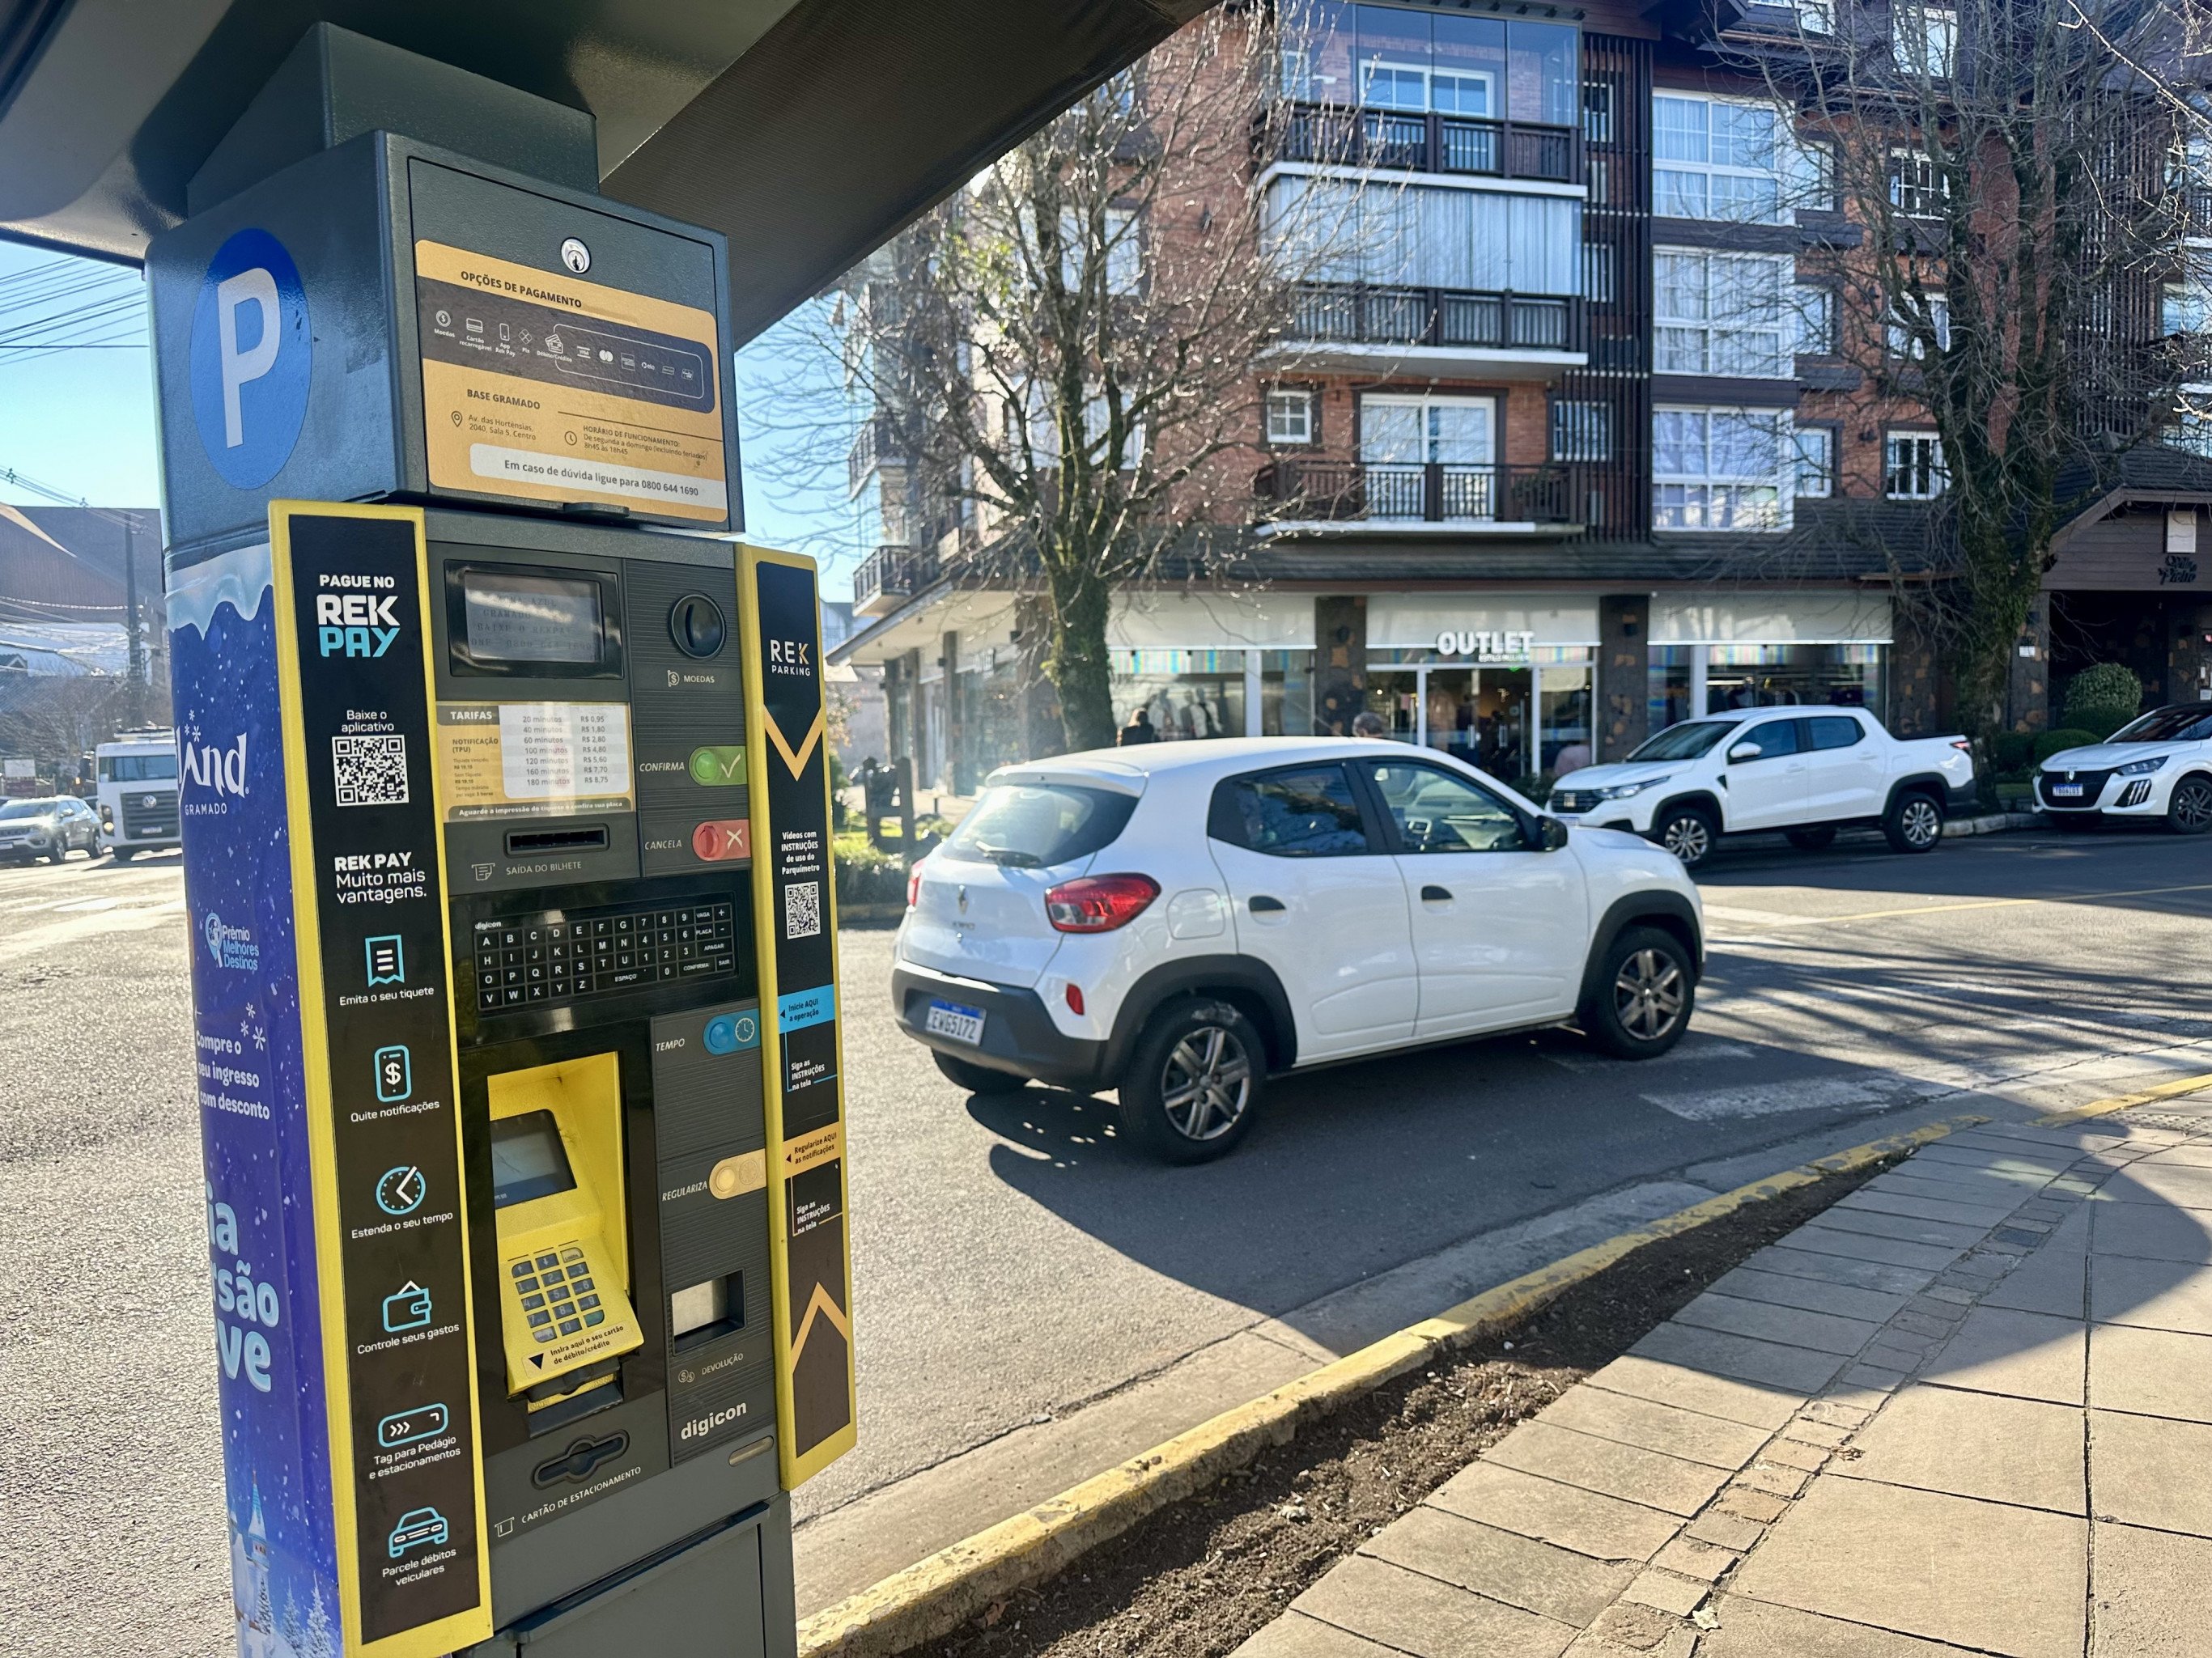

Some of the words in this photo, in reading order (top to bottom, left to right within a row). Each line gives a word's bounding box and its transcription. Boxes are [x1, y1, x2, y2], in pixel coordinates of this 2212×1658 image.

[461, 270, 502, 289] OPÇÕES
[504, 282, 517, 292] DE
[520, 285, 582, 307] PAGAMENTO
[434, 328, 456, 338] Moedas
[466, 335, 484, 344] Cartão
[459, 341, 492, 352] recarregável
[218, 267, 281, 448] P
[467, 389, 490, 401] BASE
[493, 394, 541, 409] GRAMADO
[468, 414, 478, 422] Av.
[481, 417, 494, 425] das
[495, 419, 534, 432] Hortênsias,
[469, 423, 487, 433] 2040,
[490, 427, 503, 435] Sala
[513, 430, 536, 440] Centro
[584, 426, 613, 436] HORÁRIO
[625, 432, 680, 447] FUNCIONAMENTO:
[594, 435, 620, 446] segunda
[626, 441, 652, 452] domingo
[610, 447, 628, 455] 18h45
[504, 460, 520, 471] Em
[523, 464, 544, 474] caso
[547, 466, 558, 476] de
[562, 469, 592, 481] dúvida
[595, 473, 617, 486] ligue
[620, 478, 639, 488] para
[642, 481, 661, 490] 0800
[664, 483, 677, 494] 644
[681, 486, 698, 496] 1690
[320, 575, 371, 587] PAGUE
[374, 576, 395, 588] NO
[316, 594, 401, 626] REK
[319, 626, 401, 658] PAY
[1437, 631, 1535, 655] OUTLET
[771, 639, 809, 664] REK
[683, 675, 715, 683] MOEDAS
[772, 665, 810, 676] PARKING
[346, 710, 377, 720] Baixe
[380, 711, 387, 719] o
[450, 711, 492, 720] TARIFAS
[591, 715, 605, 723] 0,95
[342, 722, 394, 735] aplicativo
[452, 737, 499, 745] NOTIFICAÇÃO
[592, 736, 606, 744] 2,80
[639, 762, 685, 772] CONFIRMA
[185, 803, 227, 816] GRAMADO
[459, 808, 488, 816] Aguarde
[495, 806, 529, 814] impressão
[782, 832, 803, 840] Vídeos
[644, 840, 682, 850] CANCELA
[782, 840, 818, 851] INSTRUÇÕES
[334, 854, 371, 871] REK
[375, 852, 411, 868] PAY
[786, 854, 794, 863] de
[507, 864, 533, 876] SAÍDA
[535, 864, 548, 872] DO
[550, 861, 581, 871] BILHETE
[782, 864, 820, 876] Parquímetro
[336, 872, 383, 888] Muito
[388, 868, 426, 884] mais
[337, 886, 427, 904] vantagens.
[222, 925, 251, 941] Prêmio
[475, 921, 501, 930] digicon
[223, 940, 259, 956] Melhores
[223, 954, 257, 971] Destinos
[683, 963, 709, 971] CONFIRMA
[340, 994, 368, 1006] Emita
[380, 992, 397, 1001] seu
[400, 986, 434, 999] tiquete
[788, 1003, 804, 1011] Inicie
[805, 999, 819, 1007] AQUI
[794, 1009, 819, 1021] operação
[196, 1030, 232, 1055] Compre
[235, 1041, 241, 1054] o
[656, 1038, 685, 1052] TEMPO
[198, 1062, 210, 1078] seu
[212, 1061, 259, 1088] ingresso
[792, 1062, 803, 1071] Siga
[792, 1064, 825, 1080] INSTRUÇÕES
[800, 1079, 811, 1088] tela
[200, 1091, 216, 1109] com
[218, 1092, 270, 1120] desconto
[350, 1110, 378, 1122] Quite
[380, 1100, 440, 1117] notificações
[795, 1139, 823, 1154] Regularize
[824, 1132, 837, 1143] AQUI
[802, 1144, 834, 1161] notificações
[662, 1181, 707, 1202] REGULARIZA
[796, 1204, 809, 1214] Siga
[797, 1203, 830, 1225] INSTRUÇÕES
[351, 1223, 392, 1239] Estenda
[403, 1219, 421, 1229] seu
[422, 1212, 453, 1225] tempo
[806, 1220, 817, 1231] tela
[357, 1338, 400, 1355] Controle
[402, 1332, 426, 1345] seus
[427, 1324, 460, 1340] gastos
[550, 1345, 570, 1355] Insira
[571, 1339, 585, 1350] aqui
[592, 1334, 603, 1342] seu
[604, 1325, 624, 1338] cartão
[554, 1356, 562, 1364] de
[564, 1340, 610, 1361] débito/crédito
[702, 1353, 743, 1375] DEVOLUÇÃO
[681, 1402, 746, 1440] digicon
[374, 1453, 393, 1466] Tag
[394, 1448, 416, 1461] para
[418, 1435, 456, 1453] Pedágio
[378, 1448, 461, 1477] estacionamentos
[522, 1503, 555, 1524] CARTÃO
[558, 1498, 568, 1508] DE
[570, 1466, 641, 1503] ESTACIONAMENTO
[382, 1560, 418, 1578] Parcele
[421, 1548, 456, 1566] débitos
[396, 1565, 445, 1586] veiculares
